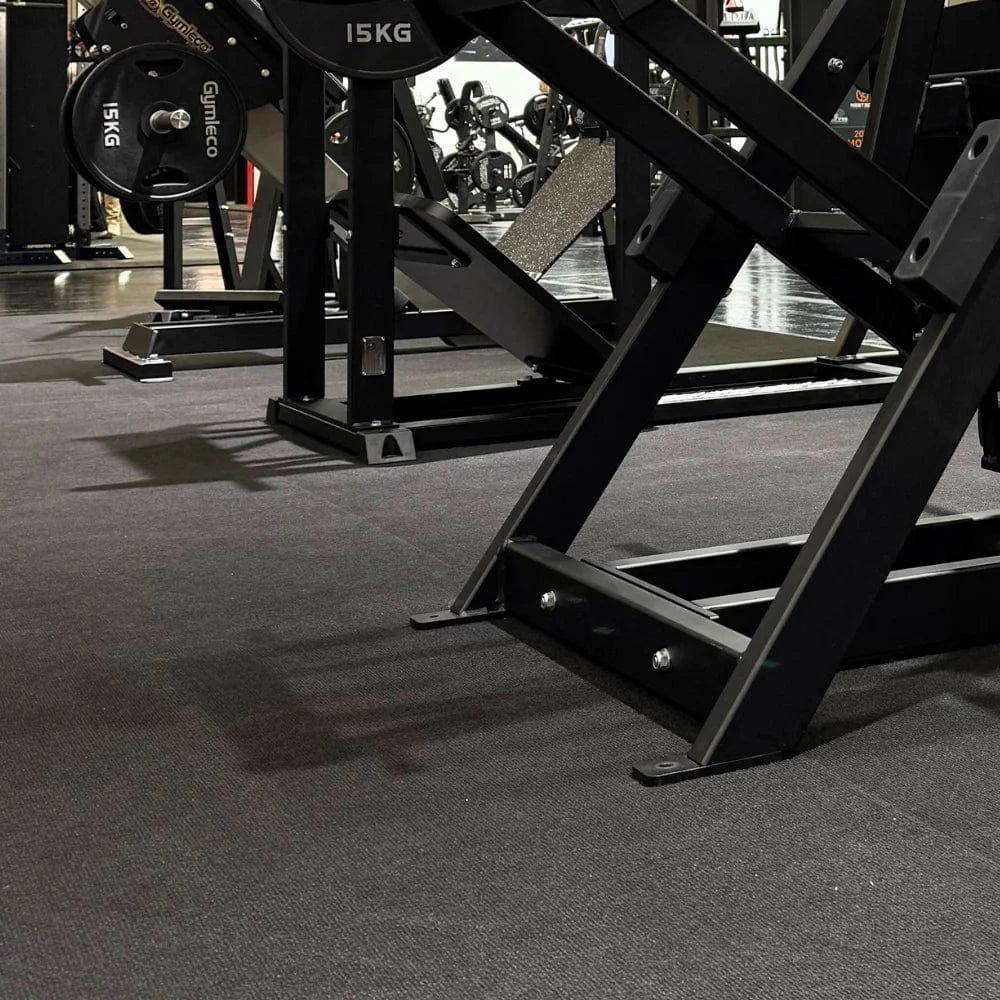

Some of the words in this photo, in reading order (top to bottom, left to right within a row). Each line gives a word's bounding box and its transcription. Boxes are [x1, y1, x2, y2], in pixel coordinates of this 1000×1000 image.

[162, 4, 210, 52] Gymleco
[347, 23, 412, 43] 15KG
[102, 102, 121, 149] 15KG
[200, 81, 221, 158] Gymleco
